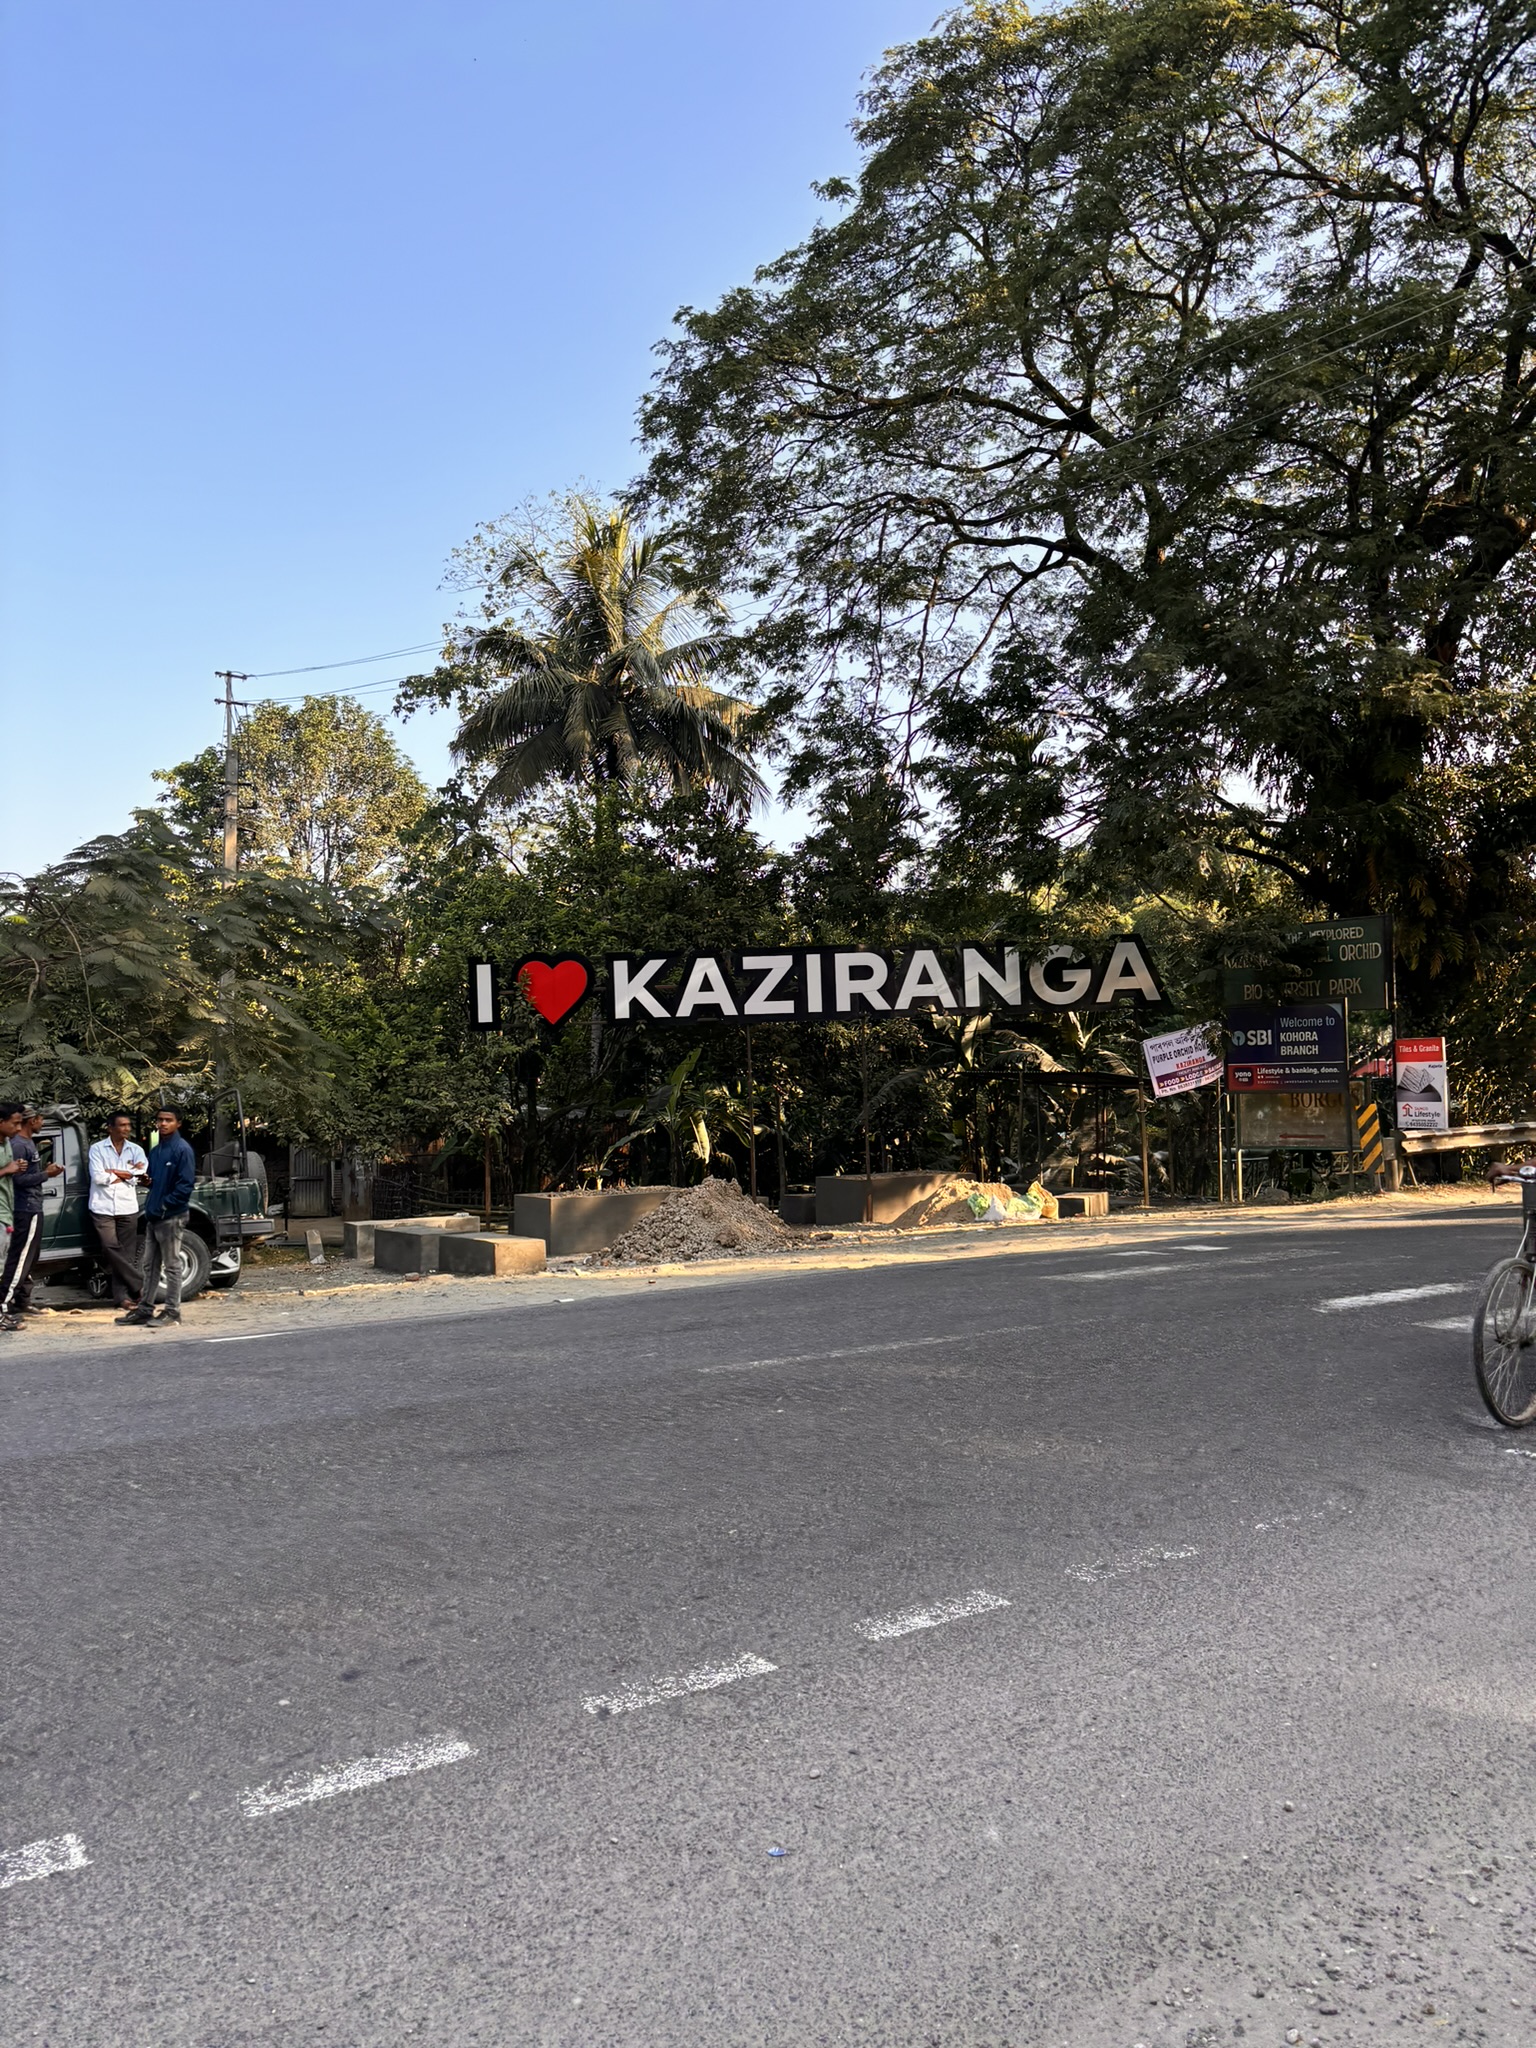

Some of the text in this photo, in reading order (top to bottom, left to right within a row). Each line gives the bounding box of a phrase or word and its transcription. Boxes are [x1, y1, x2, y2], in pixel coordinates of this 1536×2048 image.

[1339, 942, 1382, 961] ORCHID
[475, 941, 1162, 1023] I KAZIRANGA
[1329, 977, 1362, 995] PARK
[1280, 1016, 1335, 1028] Welcome to
[1246, 1029, 1272, 1046] SBI
[1280, 1031, 1318, 1042] KOHORA
[1152, 1051, 1173, 1064] PURPLE
[1173, 1045, 1194, 1058] ORCHID
[1280, 1045, 1319, 1056] BRANCH
[1234, 1071, 1252, 1079] yono
[1257, 1067, 1283, 1075] Lifestyle
[1164, 1077, 1180, 1087] FOOD
[1414, 1111, 1440, 1119] Lifestyle
